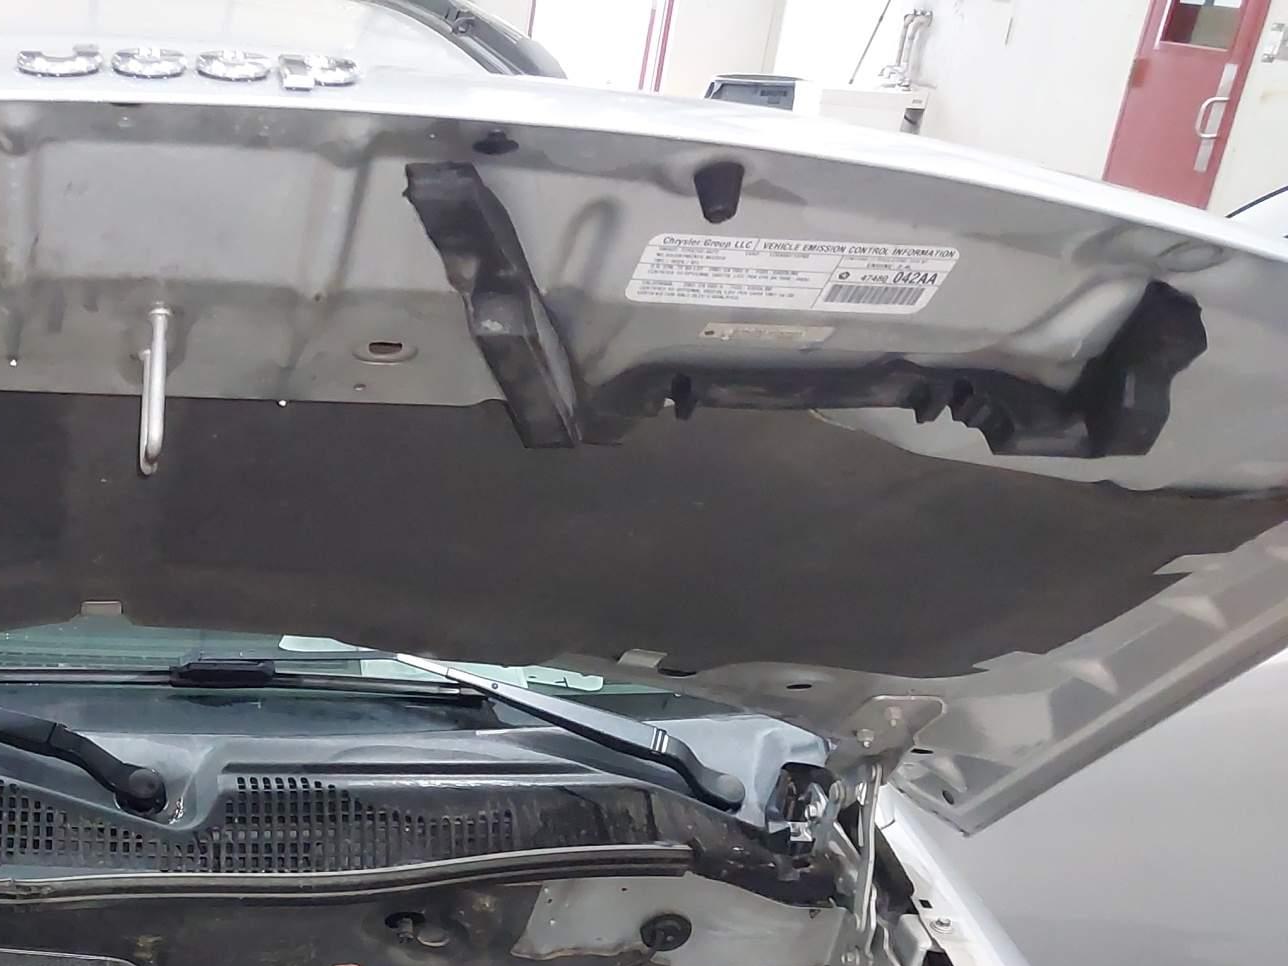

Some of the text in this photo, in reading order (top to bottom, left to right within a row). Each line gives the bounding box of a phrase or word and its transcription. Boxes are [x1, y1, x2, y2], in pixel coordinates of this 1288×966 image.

[662, 236, 702, 248] Chrysler
[703, 239, 732, 249] Group
[734, 239, 754, 249] LLC
[762, 242, 801, 252] VEHICLE
[802, 244, 847, 254] EMISSION
[848, 246, 890, 256] CONTROL
[892, 247, 956, 258] INFORMATION
[892, 271, 939, 285] 042AA
